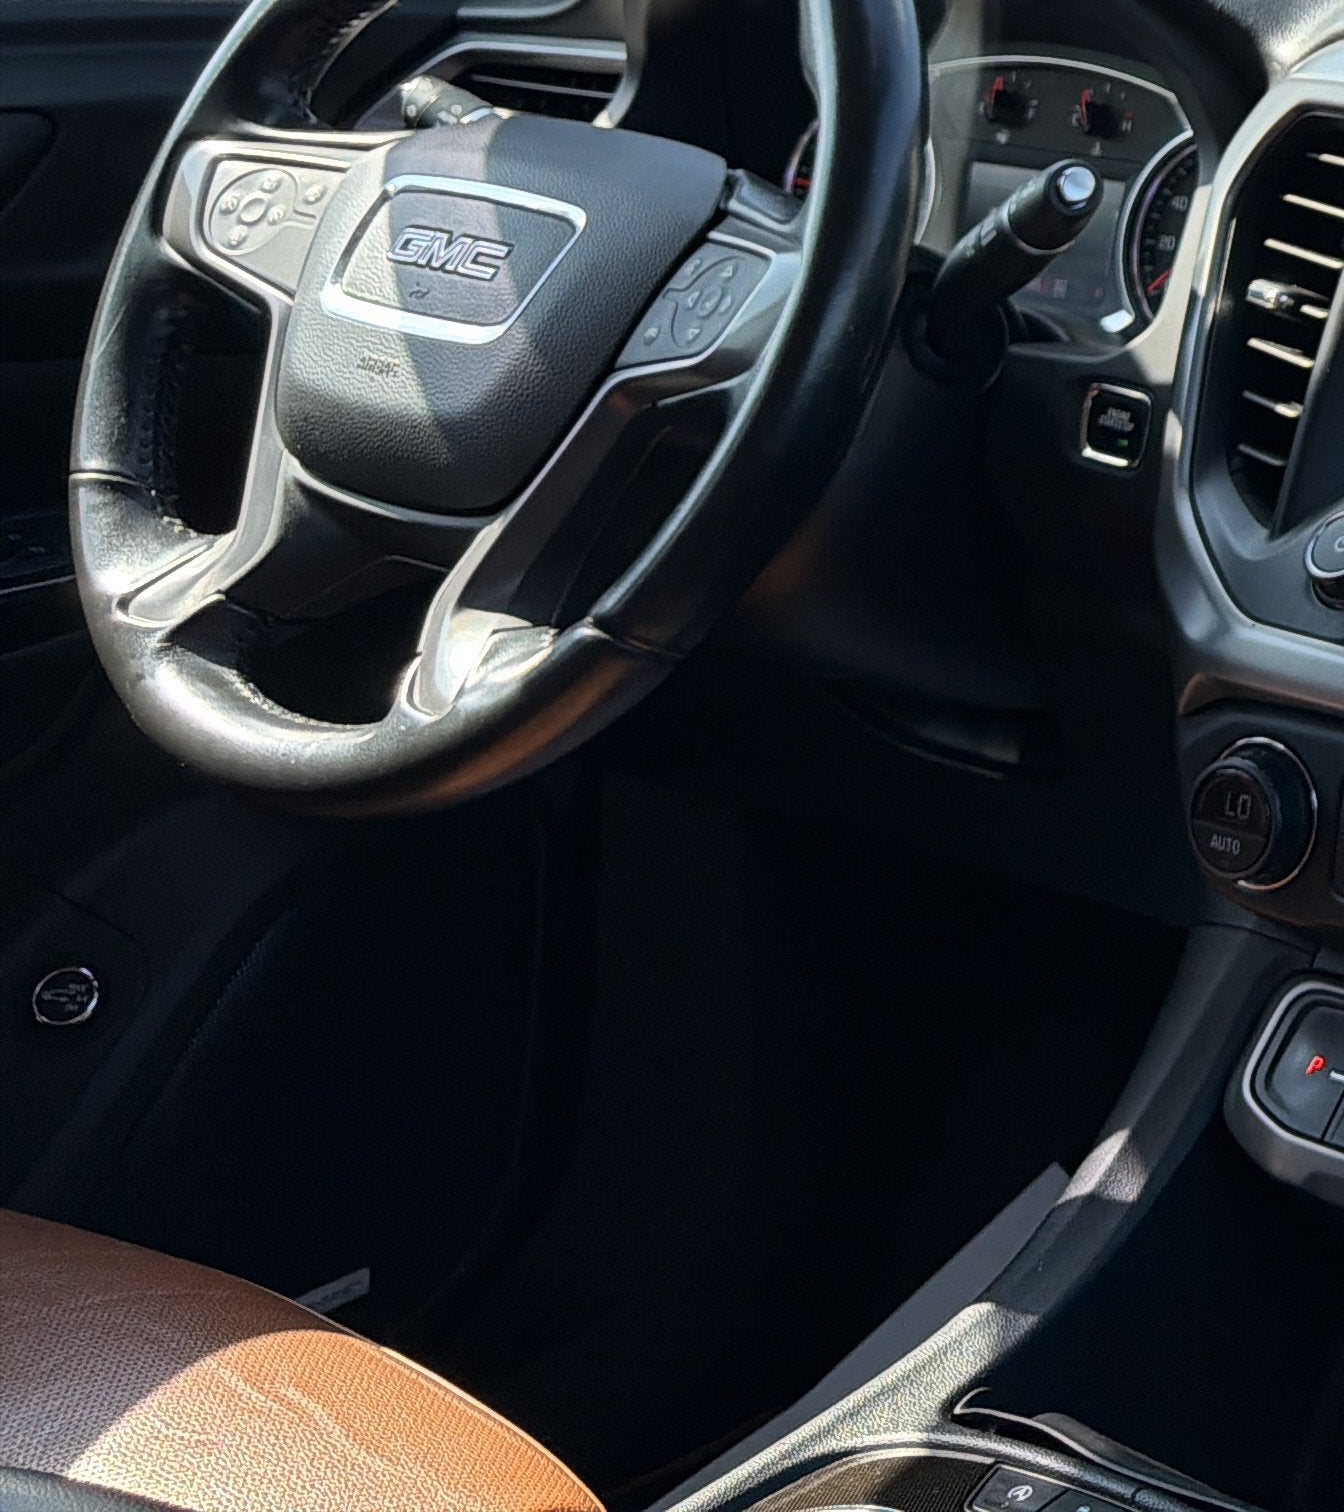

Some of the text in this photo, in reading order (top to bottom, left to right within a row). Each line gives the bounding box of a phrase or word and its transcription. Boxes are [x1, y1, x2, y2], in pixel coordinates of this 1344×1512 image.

[386, 224, 515, 281] GMC
[1210, 833, 1241, 856] AUTO
[1305, 1055, 1326, 1076] P
